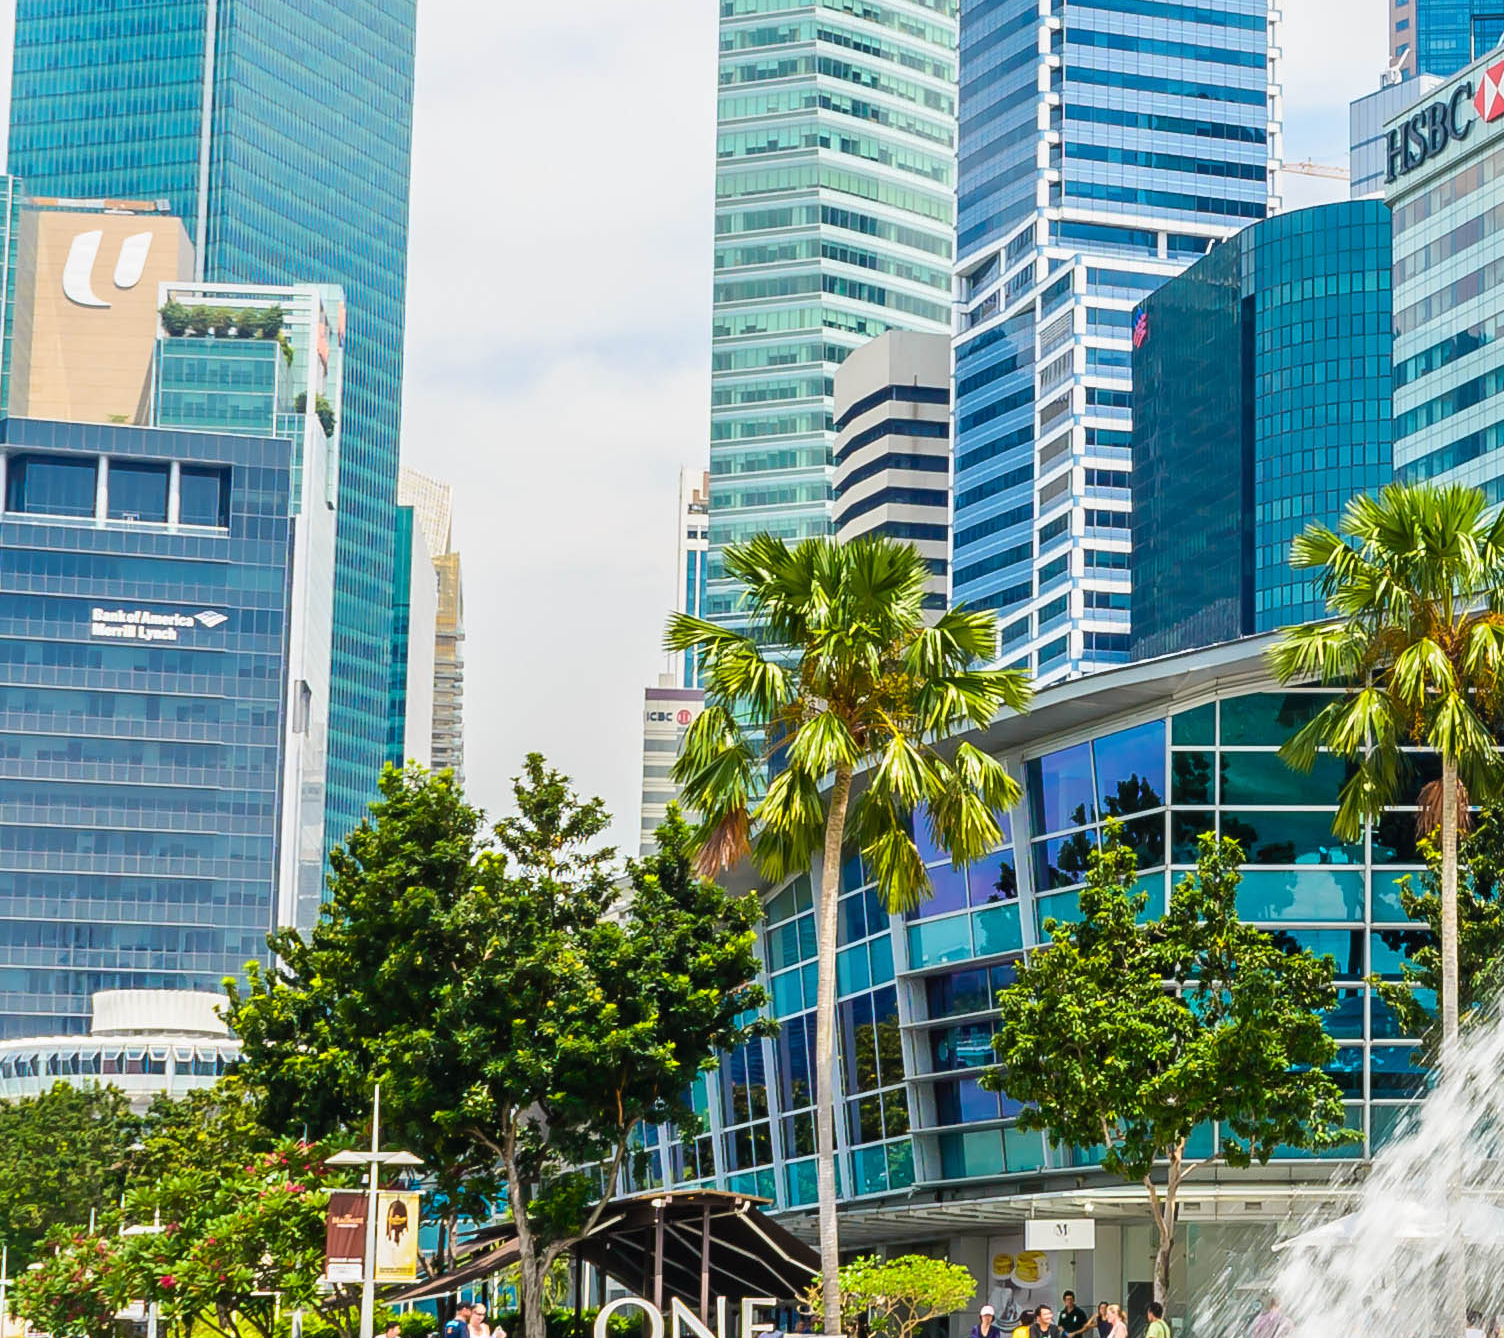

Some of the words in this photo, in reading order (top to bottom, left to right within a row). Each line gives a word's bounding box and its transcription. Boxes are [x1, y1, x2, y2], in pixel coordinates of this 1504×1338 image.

[1383, 83, 1476, 185] HSBC
[92, 607, 126, 622] Bank
[141, 611, 195, 628] America
[91, 622, 137, 638] Merrill
[138, 625, 177, 641] Lynch
